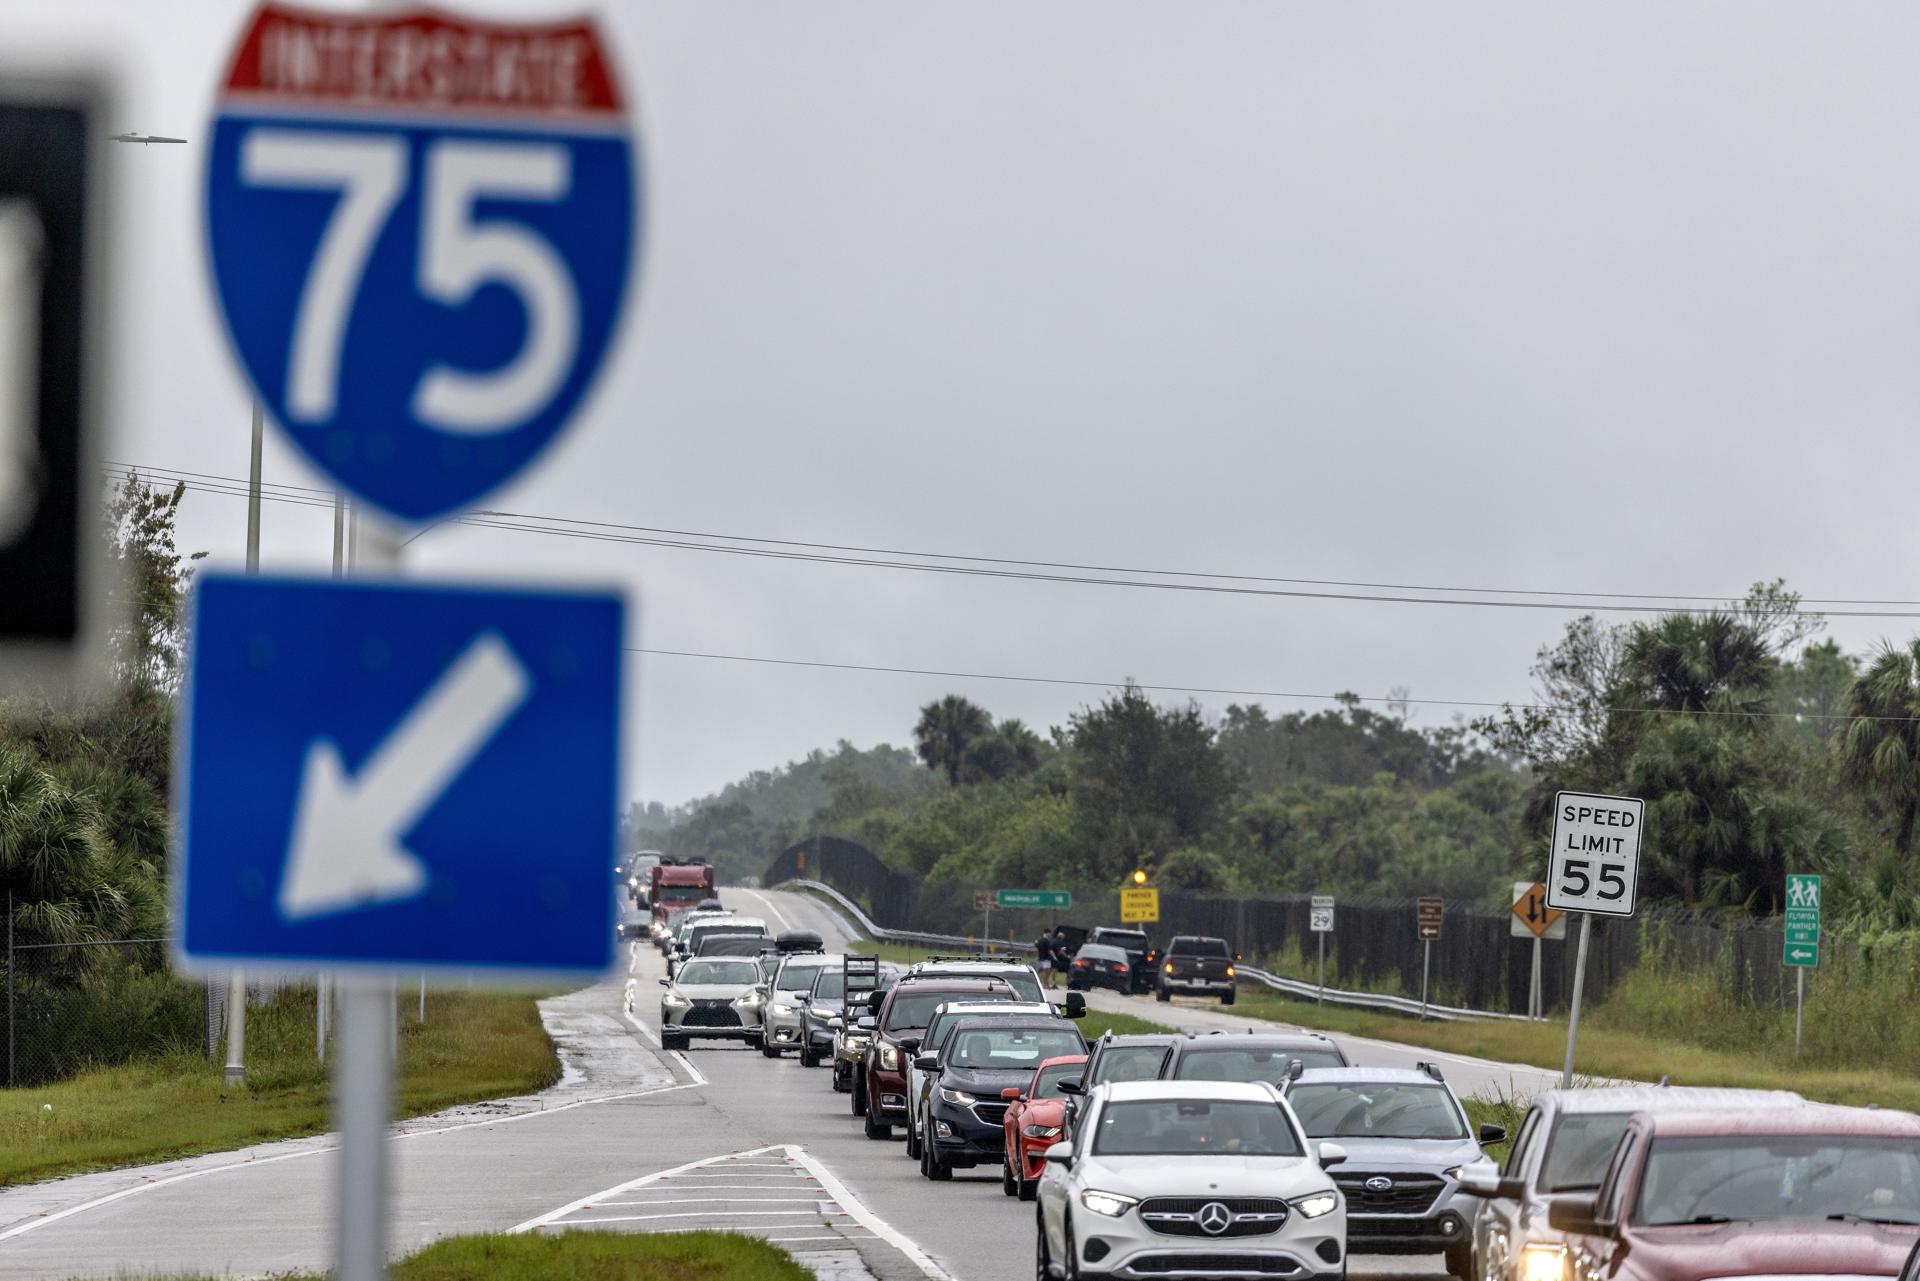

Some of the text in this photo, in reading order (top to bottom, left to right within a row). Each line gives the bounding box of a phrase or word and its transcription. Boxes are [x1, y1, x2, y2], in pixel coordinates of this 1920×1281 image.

[258, 24, 584, 105] INTERSTATE
[240, 130, 582, 435] 75
[1562, 805, 1635, 828] SPEED
[1567, 833, 1625, 854] LIMIT
[1560, 859, 1626, 901] 55
[1313, 916, 1329, 927] 29
[1788, 912, 1815, 920] FLORIDA
[1788, 922, 1816, 930] PANTHER
